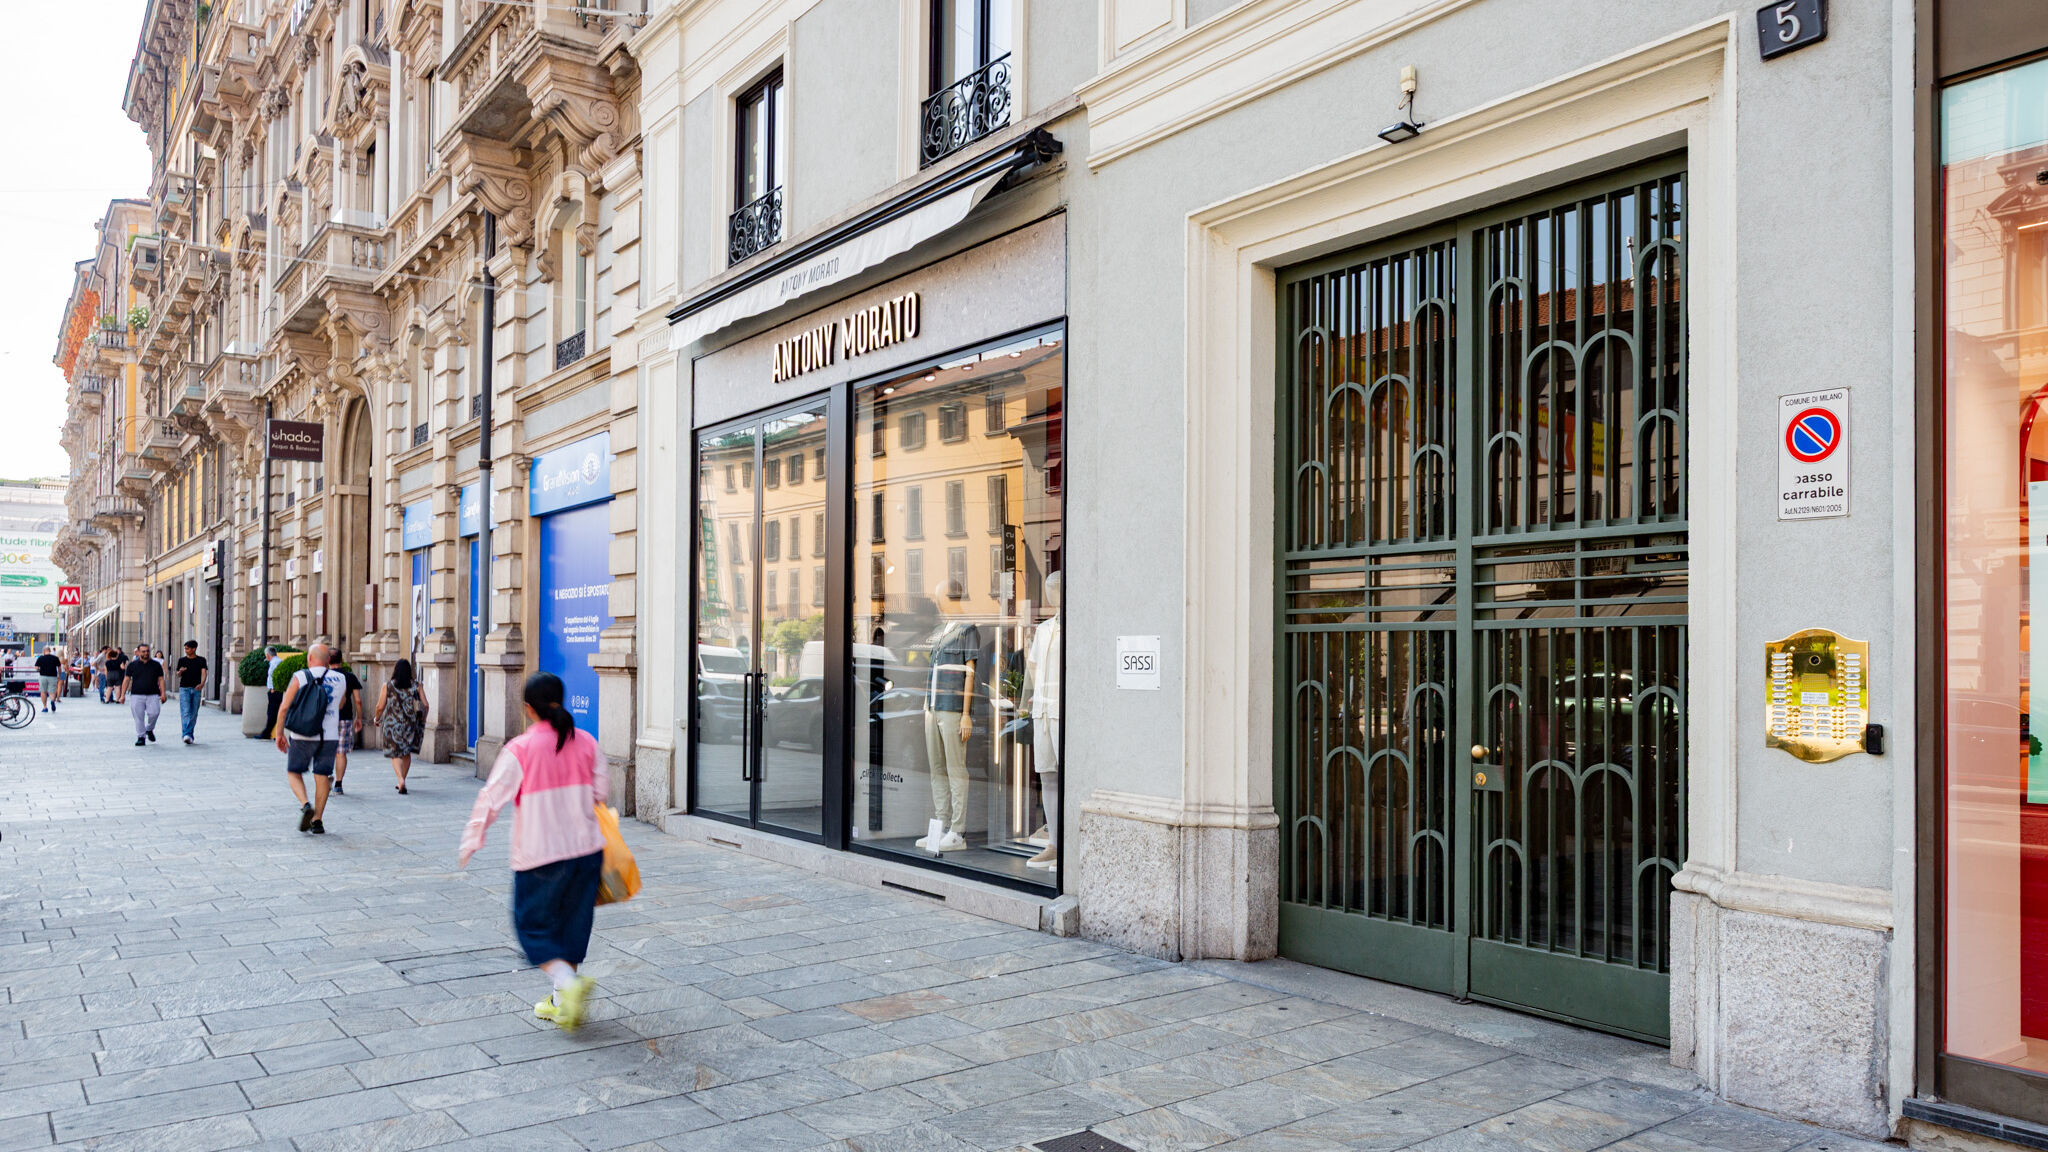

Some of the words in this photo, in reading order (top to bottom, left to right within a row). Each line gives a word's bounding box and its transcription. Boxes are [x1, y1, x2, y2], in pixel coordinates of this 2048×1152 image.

[1776, 1, 1800, 42] 5
[780, 269, 808, 297] ANTONY
[808, 257, 840, 284] MORATO
[772, 322, 837, 383] ANTONY
[841, 291, 920, 360] MORATO
[1785, 397, 1810, 407] COMUNE
[1812, 395, 1818, 403] DI
[1820, 392, 1843, 402] MILANO
[1783, 486, 1844, 500] carrabile
[60, 589, 80, 602] M
[587, 584, 609, 597] SPOSTAT
[1123, 655, 1154, 671] SASSI
